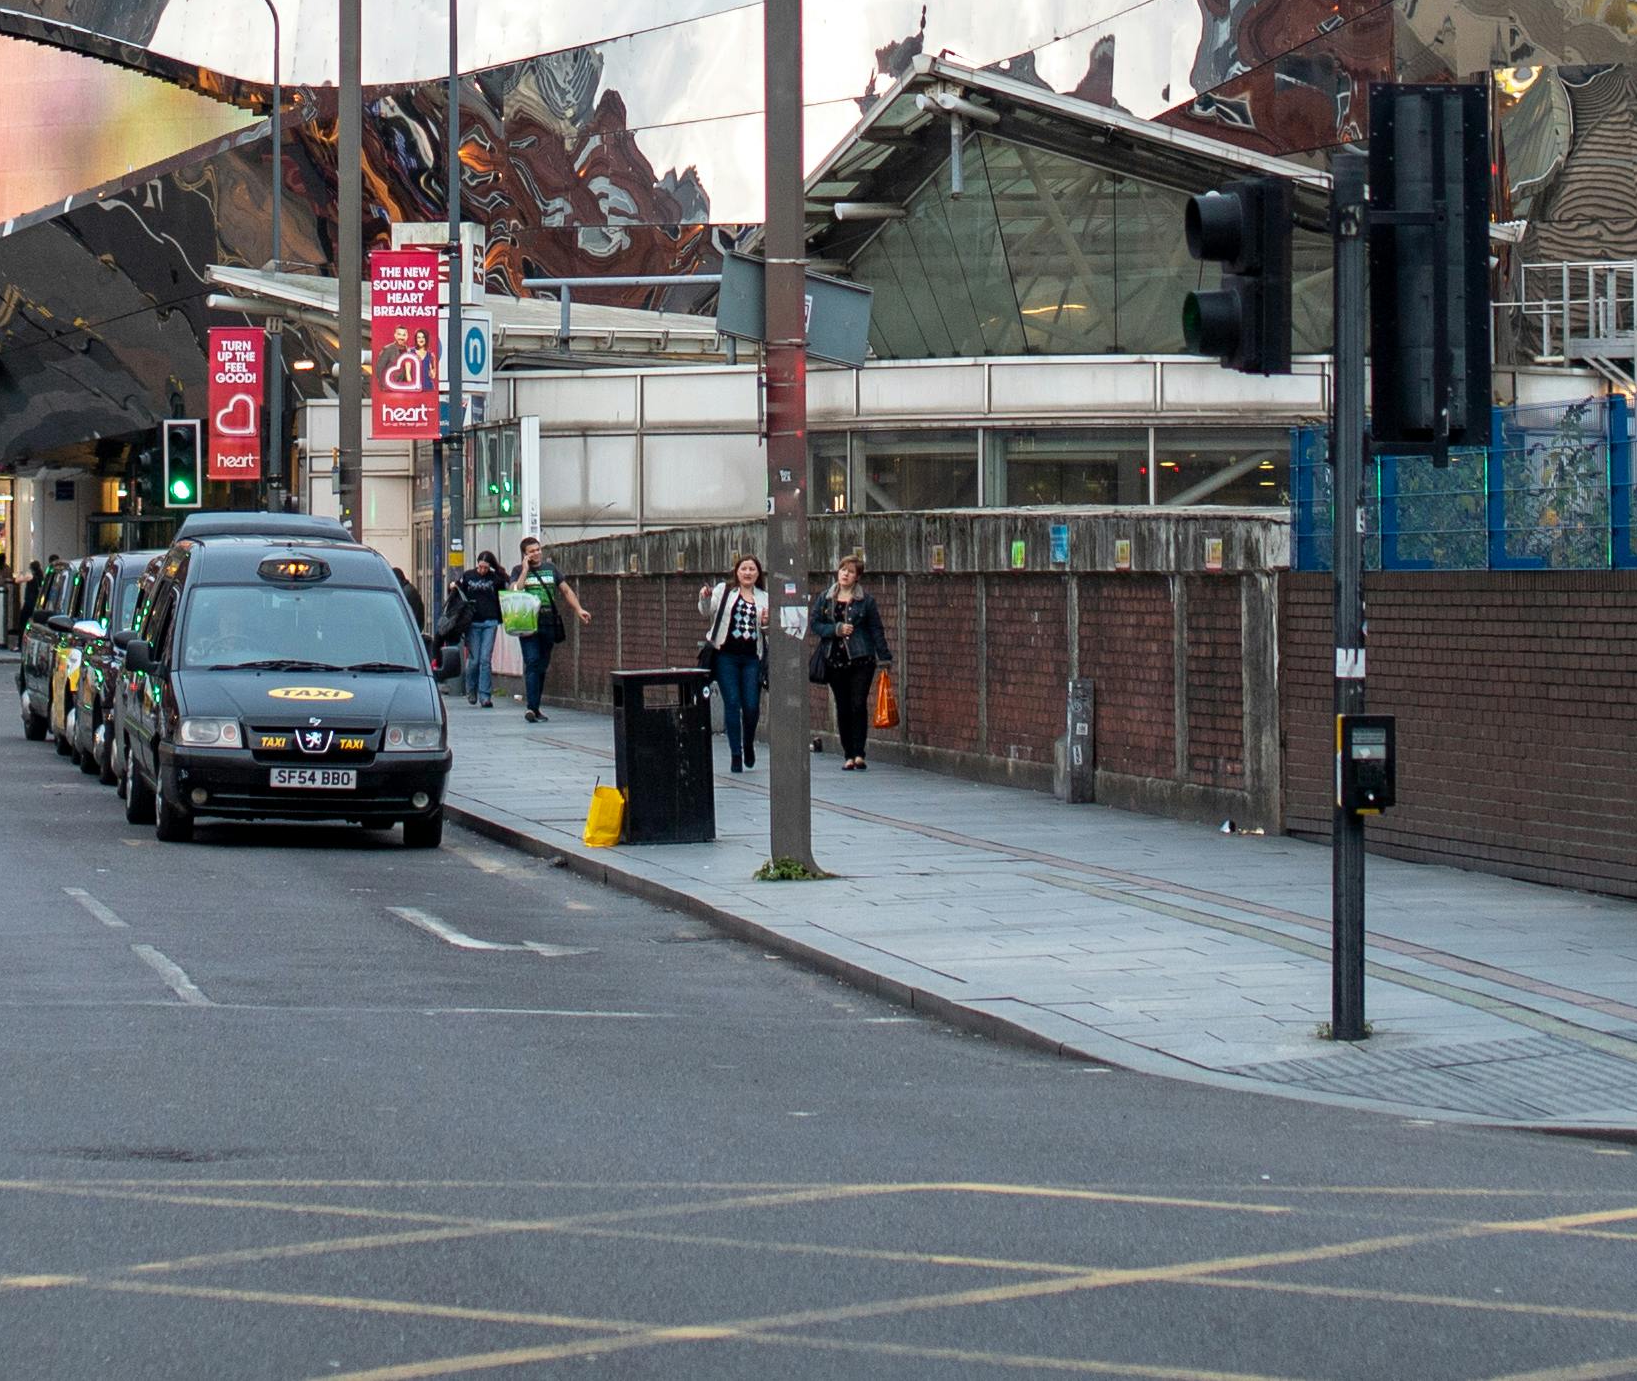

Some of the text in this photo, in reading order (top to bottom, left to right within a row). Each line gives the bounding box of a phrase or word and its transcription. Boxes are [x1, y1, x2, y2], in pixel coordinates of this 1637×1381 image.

[380, 266, 430, 278] THE NEW
[373, 279, 434, 291] SOUND OF
[387, 292, 424, 304] HEART
[373, 305, 438, 317] BREAKFAST
[221, 340, 251, 352] TURN
[217, 351, 255, 362] UP THE
[225, 362, 248, 373] FEEL
[215, 373, 257, 384] GOOD!
[382, 403, 429, 422] heart
[217, 452, 254, 468] heart
[281, 689, 341, 699] TAXI
[261, 736, 286, 748] TAXI
[339, 738, 364, 750] TAXI
[277, 769, 317, 786] SF54
